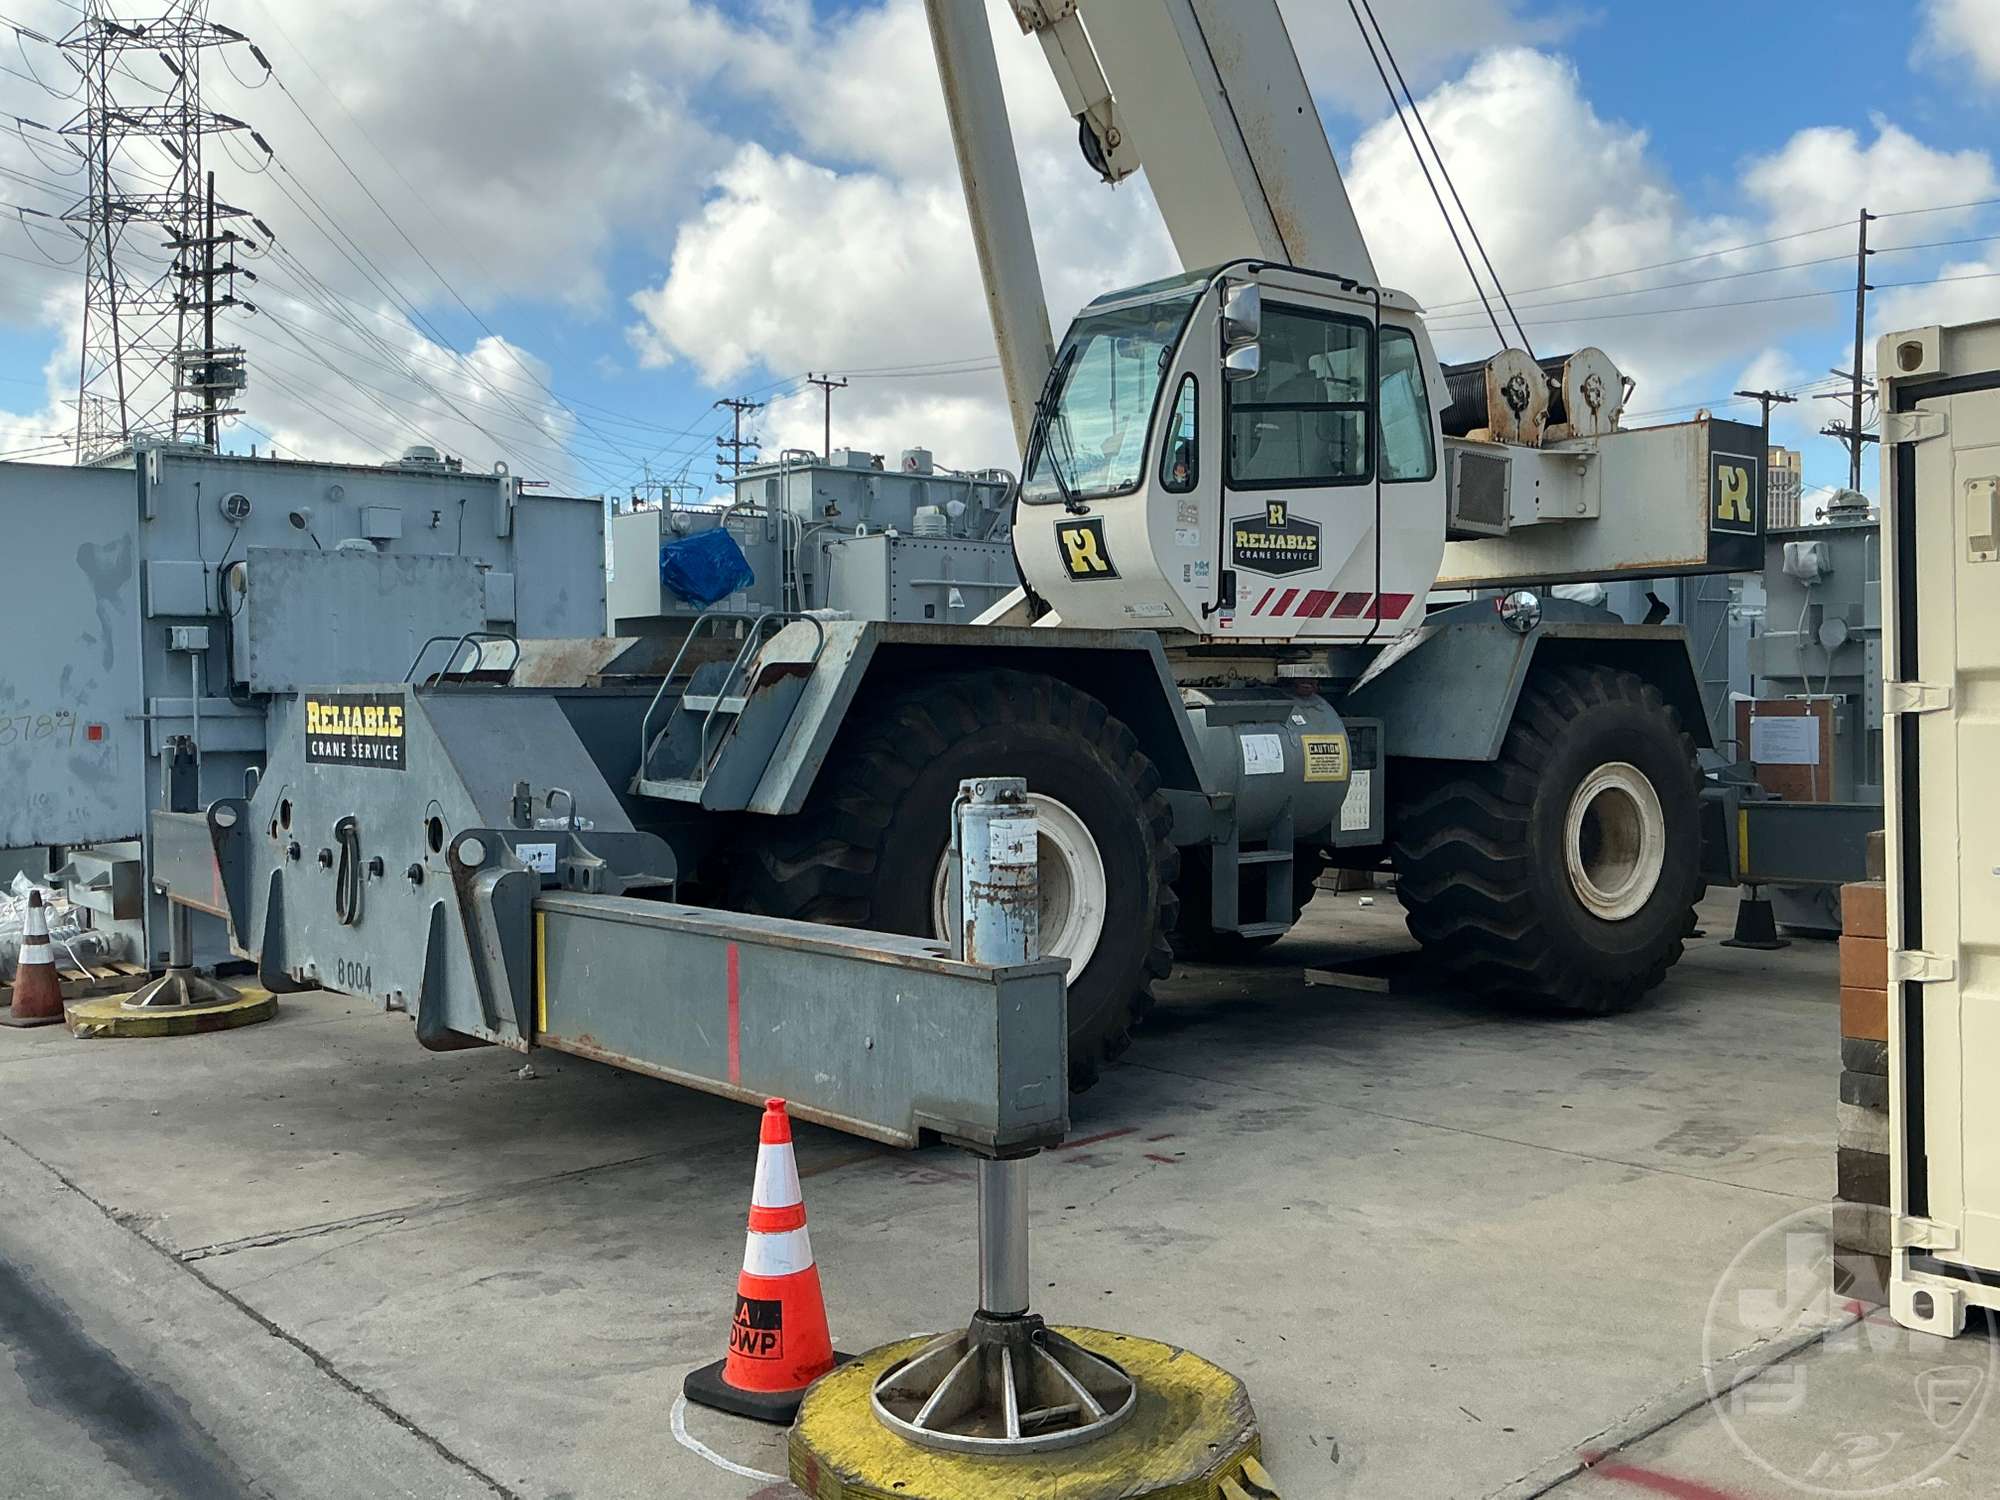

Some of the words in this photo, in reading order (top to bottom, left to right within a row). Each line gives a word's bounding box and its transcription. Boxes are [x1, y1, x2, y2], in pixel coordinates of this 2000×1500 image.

[1718, 465, 1751, 521] R
[1269, 504, 1284, 524] R
[1062, 528, 1108, 572] R
[1236, 531, 1317, 550] RELIABLE
[1240, 550, 1271, 559] CRANE
[1276, 551, 1313, 560] SERVICE
[307, 701, 402, 737] RELIABLE
[311, 740, 346, 757] CRANE
[351, 743, 398, 761] SERVICE
[1309, 744, 1339, 753] CAUTION
[338, 957, 372, 994] 8004
[735, 1301, 751, 1326] A
[730, 1324, 776, 1355] DWP
